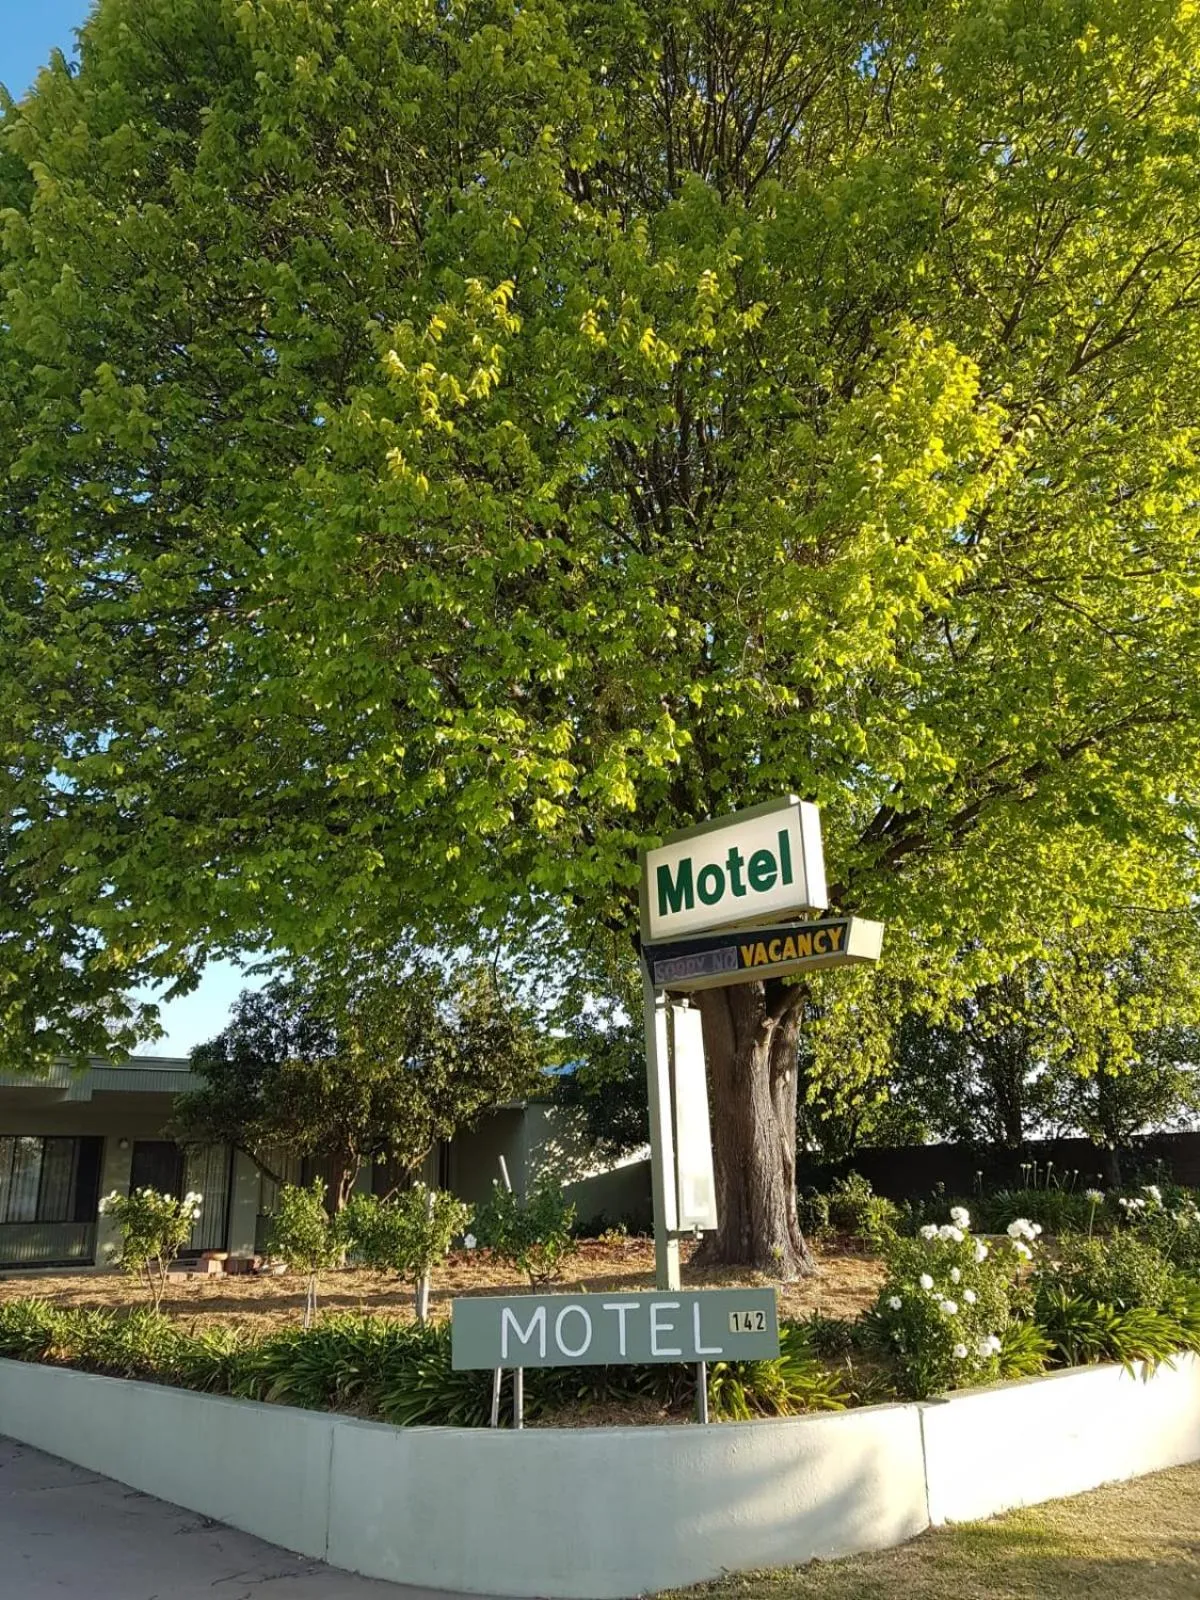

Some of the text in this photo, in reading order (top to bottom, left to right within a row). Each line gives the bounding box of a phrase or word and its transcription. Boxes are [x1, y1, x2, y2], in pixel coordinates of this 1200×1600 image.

[656, 829, 793, 916] Motel
[711, 950, 737, 970] NO
[740, 927, 844, 967] VACANCY
[502, 1301, 723, 1359] MOTEL
[732, 1311, 765, 1331] 142
